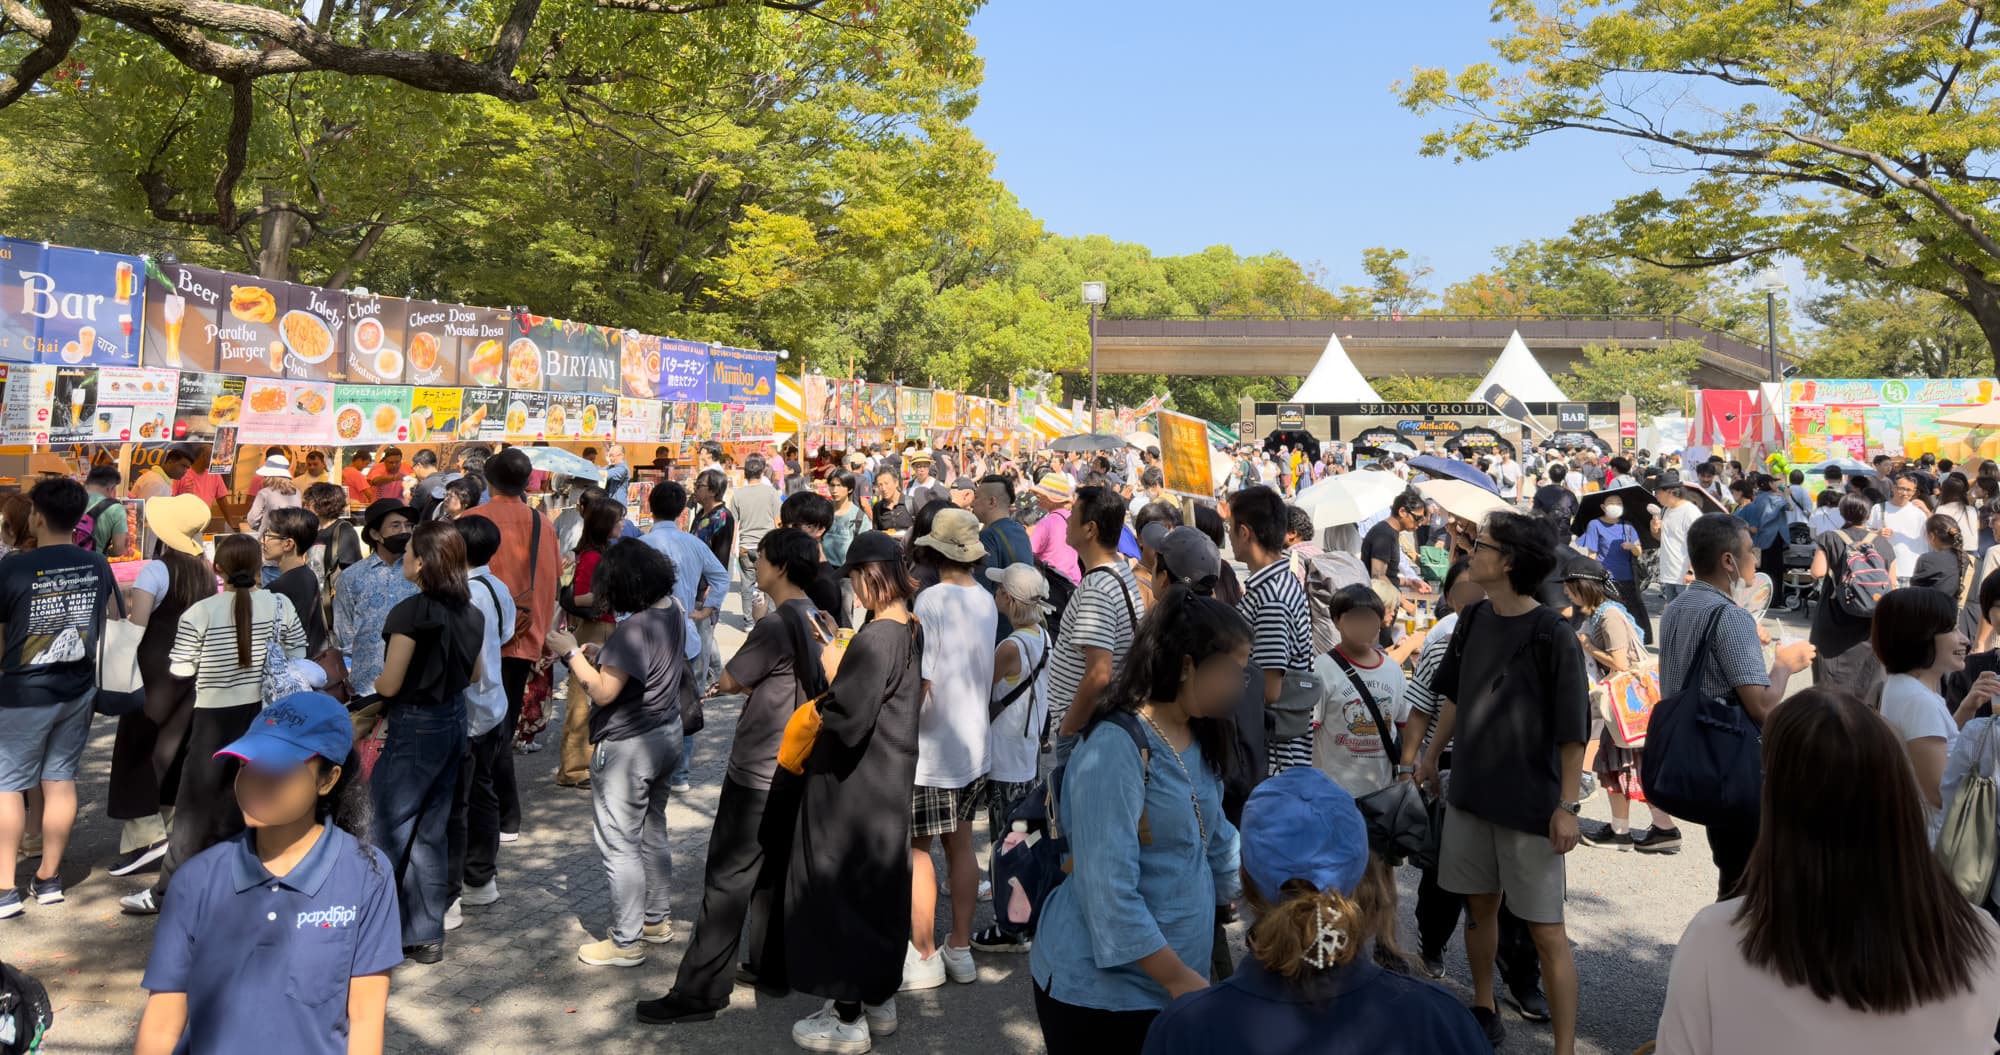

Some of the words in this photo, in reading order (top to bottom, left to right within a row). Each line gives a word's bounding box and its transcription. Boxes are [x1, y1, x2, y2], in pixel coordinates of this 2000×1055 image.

[19, 270, 104, 320] Bar
[178, 269, 219, 305] Beer
[306, 291, 345, 330] Jalebi
[348, 299, 381, 319] Chole
[409, 312, 445, 327] Cheese
[449, 308, 476, 322] Dosa
[205, 324, 256, 344] Paratha
[444, 324, 478, 337] Masala
[481, 324, 504, 337] Dosa
[23, 335, 59, 353] Chai
[221, 341, 266, 362] Burger
[284, 353, 308, 378] Chai
[546, 350, 615, 381] BIRYANI
[662, 356, 705, 376] バターチキン
[713, 361, 755, 387] Mumbai
[1360, 404, 1420, 414] SEINAN
[1428, 404, 1485, 414] GROUP
[1562, 413, 1585, 421] BAR
[32, 580, 57, 590] Dean's
[58, 575, 99, 587] Symposium
[30, 602, 65, 612] CECILIA
[31, 595, 63, 606] STACEY
[30, 608, 66, 617] ALONDRA
